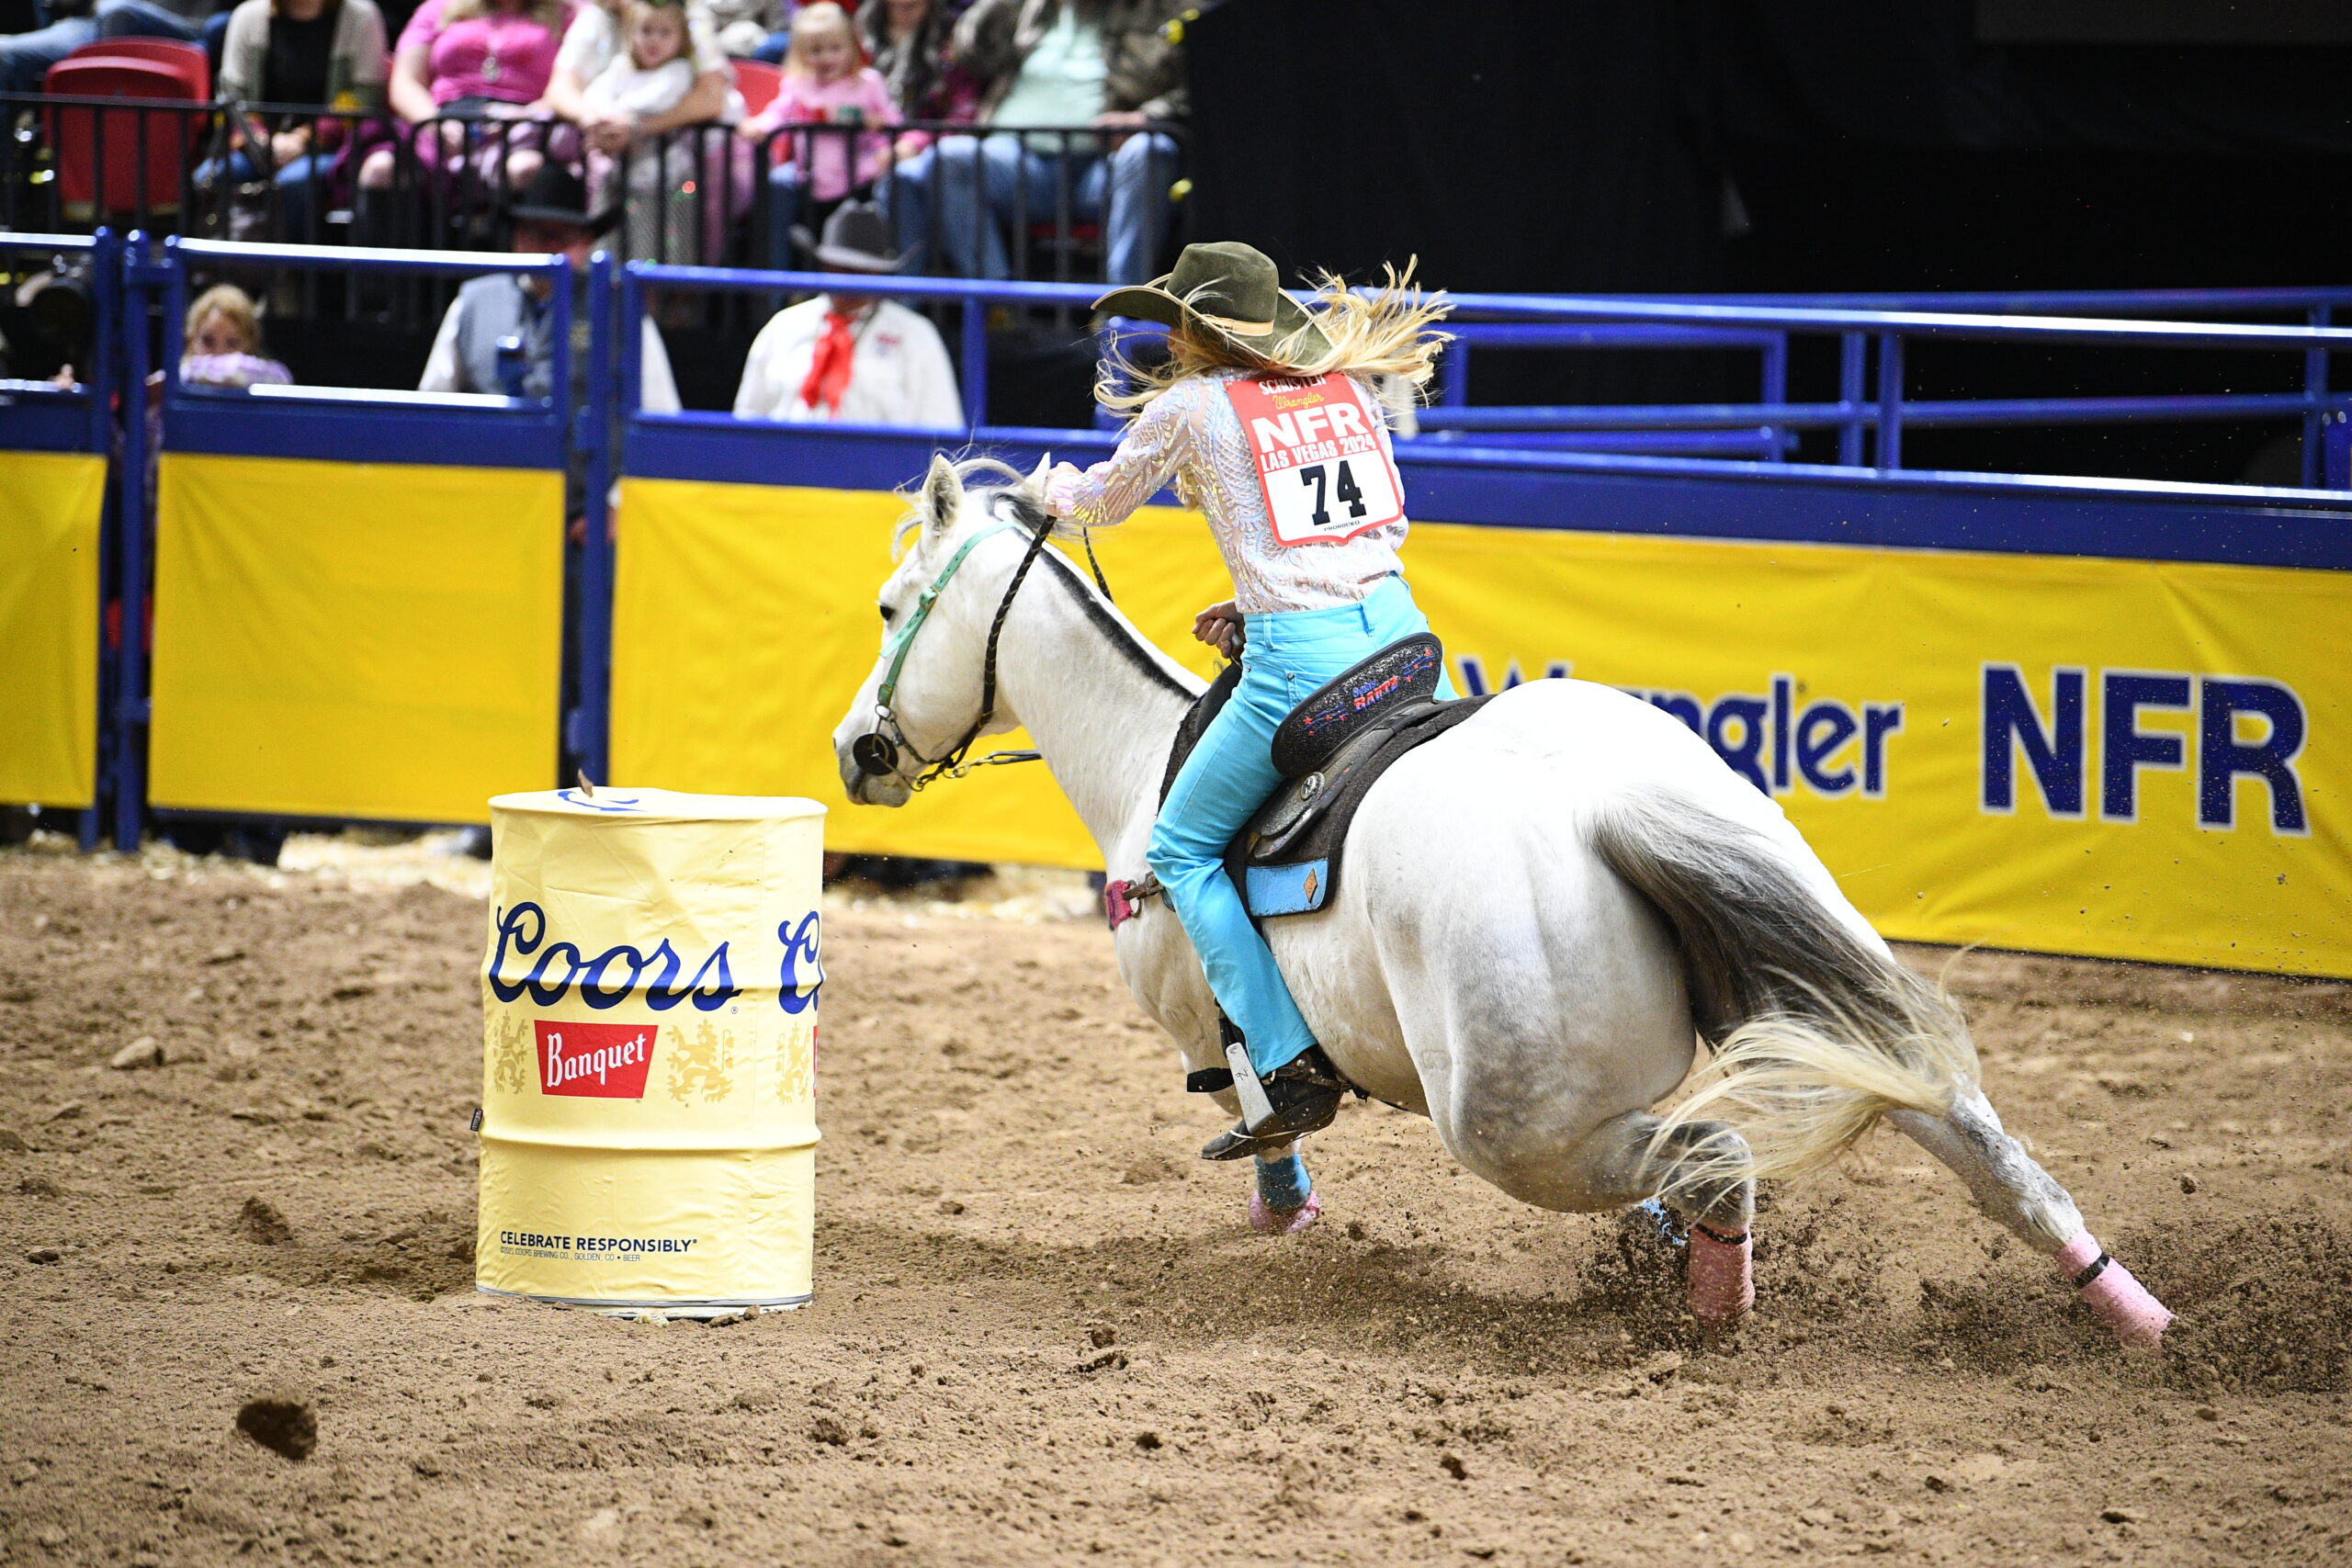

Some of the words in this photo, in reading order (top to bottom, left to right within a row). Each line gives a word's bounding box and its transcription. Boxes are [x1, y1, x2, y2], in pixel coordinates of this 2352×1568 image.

[1272, 392, 1324, 410] Wrangler
[1251, 402, 1369, 454] NFR
[1260, 449, 1290, 472] LAS
[1292, 439, 1339, 465] VEGAS
[1340, 434, 1376, 456] 2024
[1299, 459, 1367, 525] 74
[1460, 658, 1900, 798] gler
[1983, 665, 2308, 834] NFR
[489, 901, 743, 1011] Coors
[546, 1032, 647, 1088] Banquet
[500, 1231, 571, 1250] CELEBRATE
[515, 1247, 533, 1257] COORS
[533, 1249, 559, 1259] BREWING
